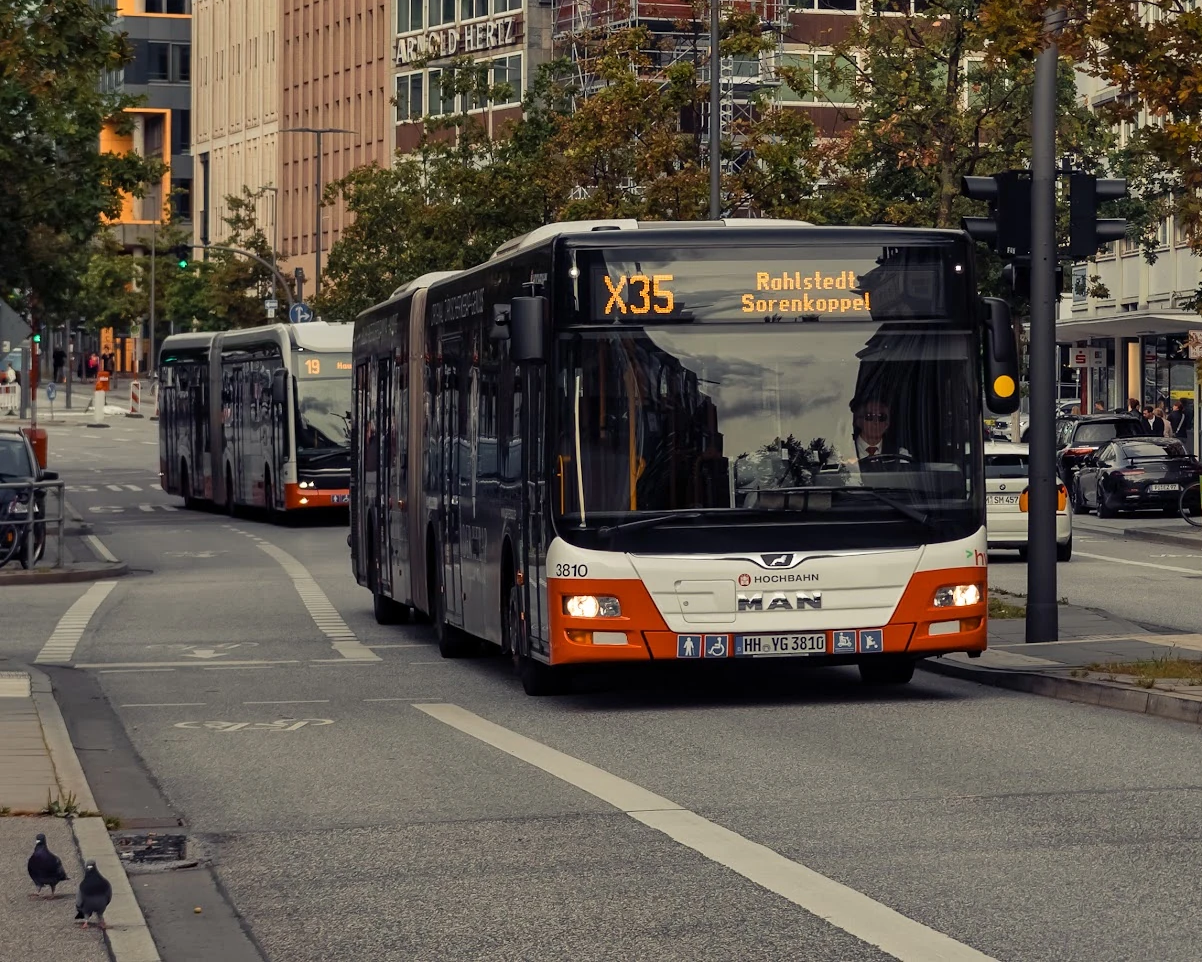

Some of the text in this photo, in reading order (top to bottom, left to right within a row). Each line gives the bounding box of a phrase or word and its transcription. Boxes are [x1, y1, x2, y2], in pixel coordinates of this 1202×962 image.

[396, 16, 515, 64] ARNOLD HERTZ
[756, 271, 857, 291] Rahlstedt
[603, 274, 674, 315] X35
[304, 359, 320, 375] 19
[994, 496, 1004, 504] SM
[1005, 496, 1018, 504] 457
[555, 563, 588, 578] 3810
[754, 574, 819, 583] HOCHBAHN
[737, 591, 822, 611] MAN
[744, 638, 761, 652] HH
[772, 636, 788, 652] YG
[791, 635, 824, 651] 3810
